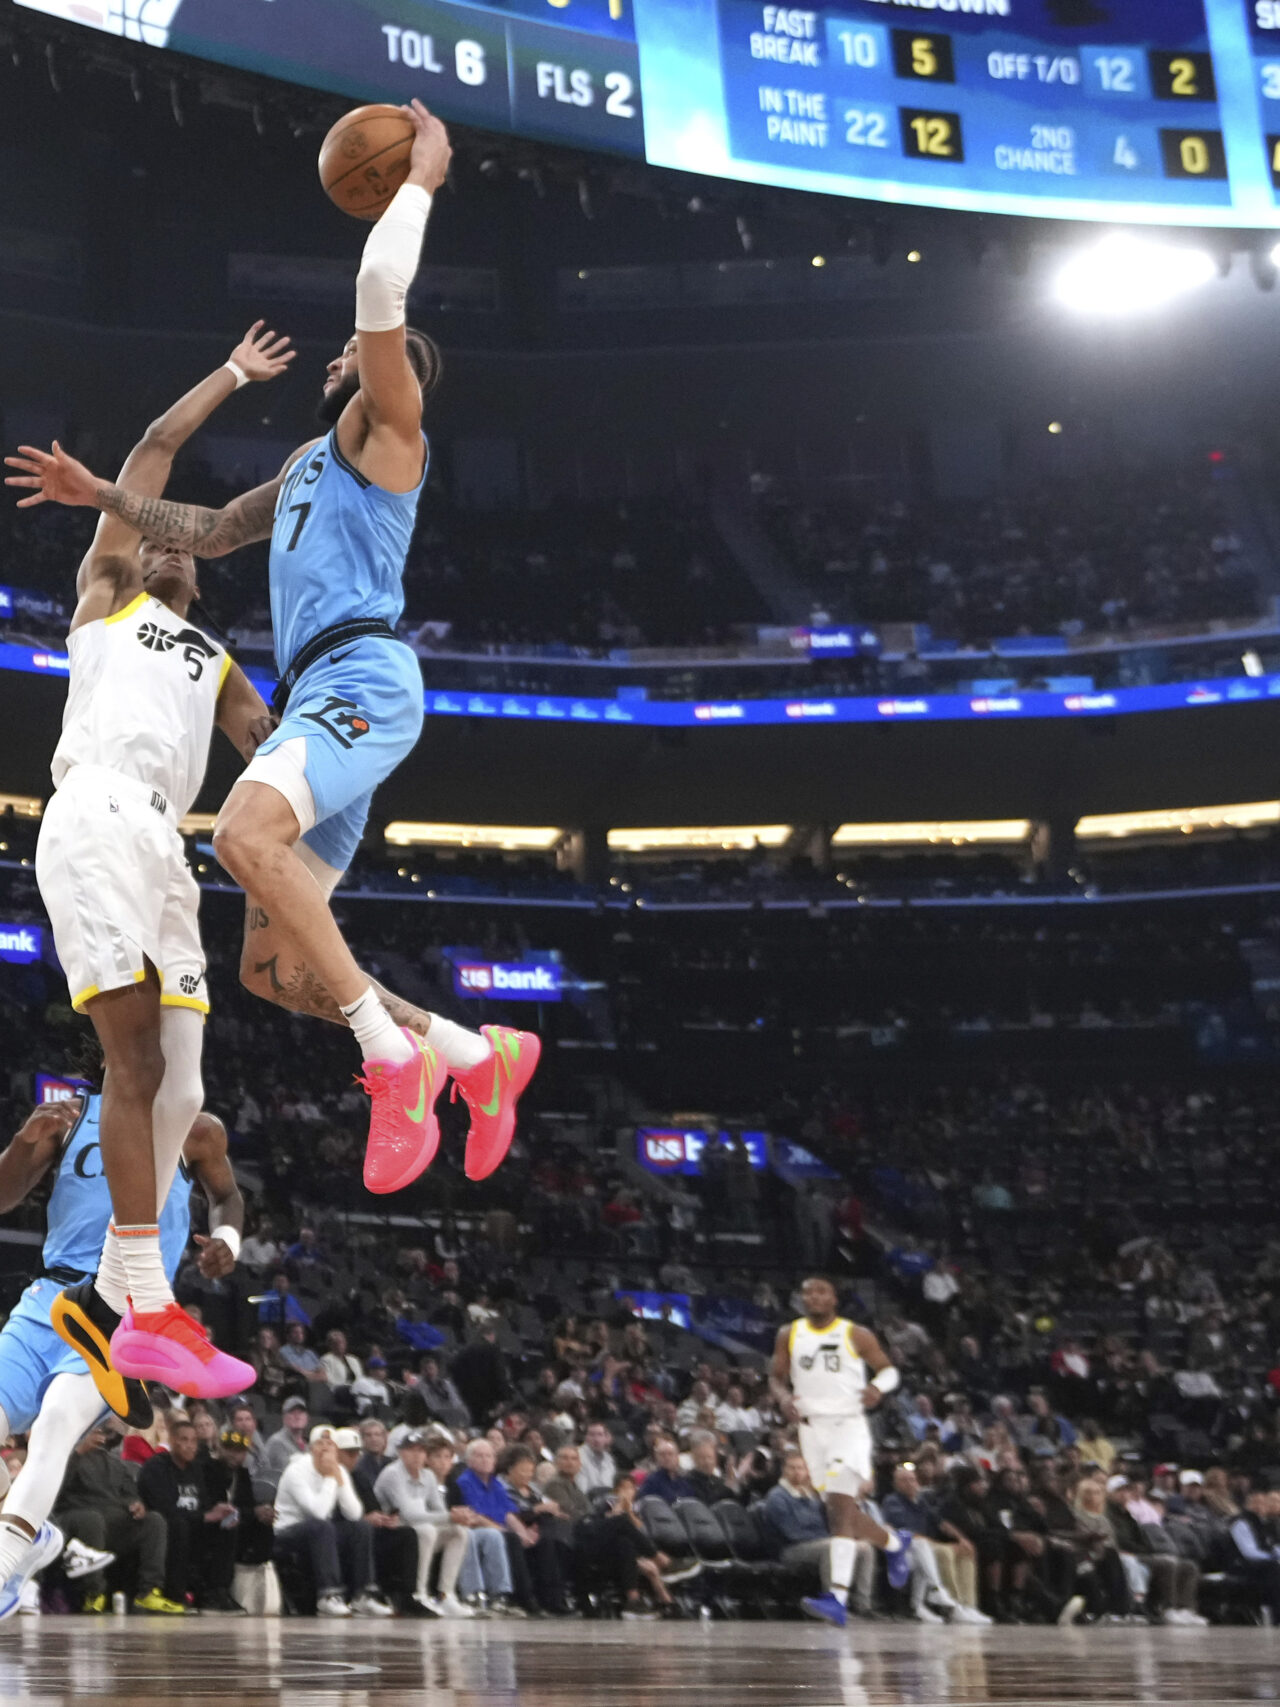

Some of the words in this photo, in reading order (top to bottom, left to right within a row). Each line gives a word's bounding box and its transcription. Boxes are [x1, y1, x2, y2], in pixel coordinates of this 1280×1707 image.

[763, 5, 817, 39] FAST
[382, 24, 443, 73] TOL
[455, 39, 487, 86] 6
[750, 31, 818, 67] BREAK
[838, 32, 877, 68] 10
[911, 38, 937, 76] 5
[536, 61, 594, 107] FLS
[604, 71, 637, 118] 2
[987, 51, 1031, 80] OFF
[1032, 54, 1080, 85] T/O
[1094, 56, 1135, 92] 12
[1169, 58, 1198, 95] 2
[758, 86, 783, 112] IN
[784, 88, 827, 120] THE
[767, 115, 829, 148] PAINT
[844, 109, 888, 148] 22
[910, 116, 954, 156] 12
[1030, 124, 1075, 150] 2ND
[994, 144, 1077, 175] CHANCE
[1113, 135, 1139, 170] 4
[1179, 136, 1210, 174] 0
[287, 502, 312, 552] 7
[183, 646, 204, 682] 5
[460, 967, 490, 989] us
[493, 966, 554, 990] bank
[646, 1138, 682, 1161] us
[823, 1353, 841, 1373] 13
